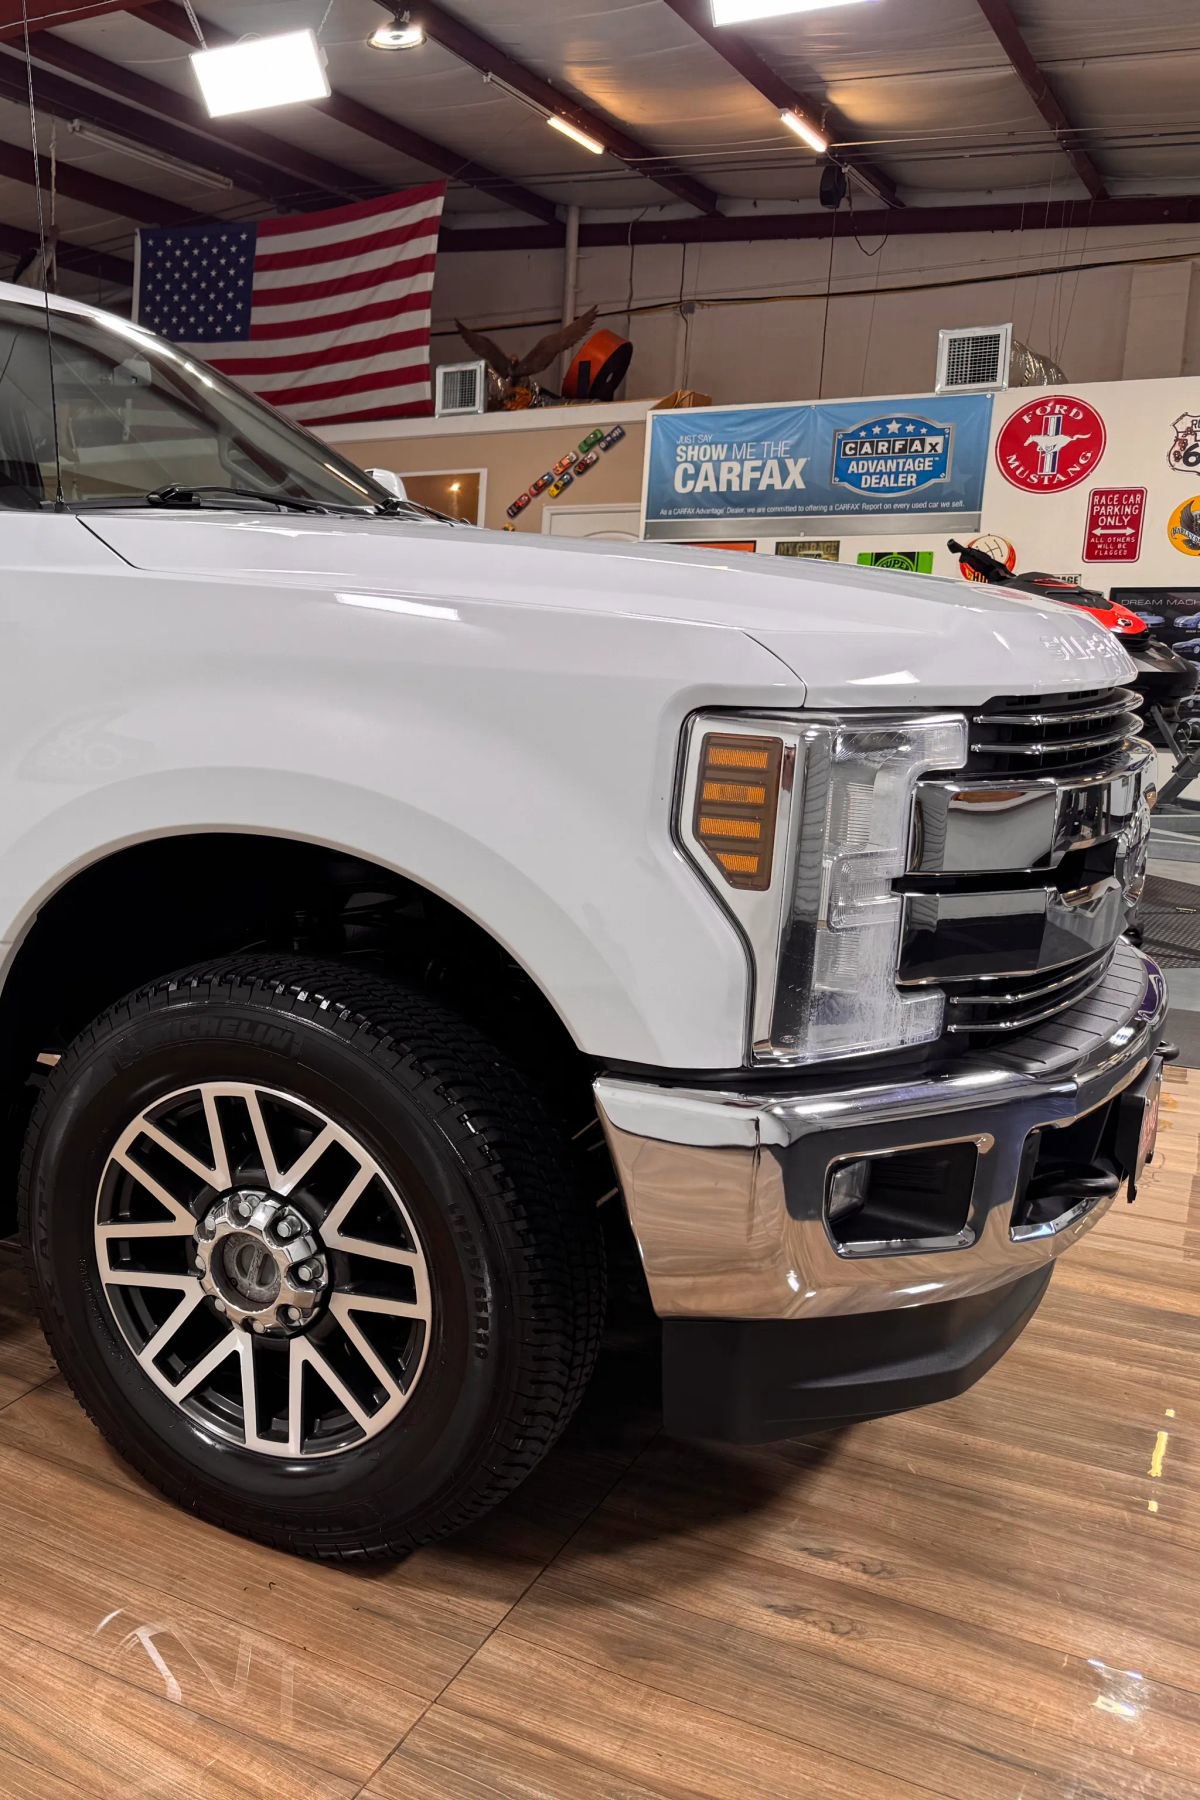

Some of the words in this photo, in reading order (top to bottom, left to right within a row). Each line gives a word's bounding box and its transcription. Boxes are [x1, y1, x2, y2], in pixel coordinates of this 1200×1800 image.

[1022, 403, 1084, 425] FORD
[676, 434, 696, 445] JUST
[697, 433, 713, 444] SAY
[676, 443, 727, 462] SHOW
[731, 443, 756, 460] ME
[759, 440, 791, 458] THE
[844, 439, 941, 457] CARFAX
[1006, 449, 1093, 486] MUSTANG
[674, 457, 808, 494] CARFAX
[861, 473, 918, 488] DEALER
[767, 505, 798, 513] committed
[805, 504, 827, 513] offering
[861, 502, 882, 511] Report
[893, 503, 910, 511] every
[911, 501, 927, 509] used
[1093, 494, 1119, 506] RACE
[1122, 494, 1142, 505] CAR
[1093, 504, 1139, 516] PARKING
[1098, 515, 1131, 527] ONLY
